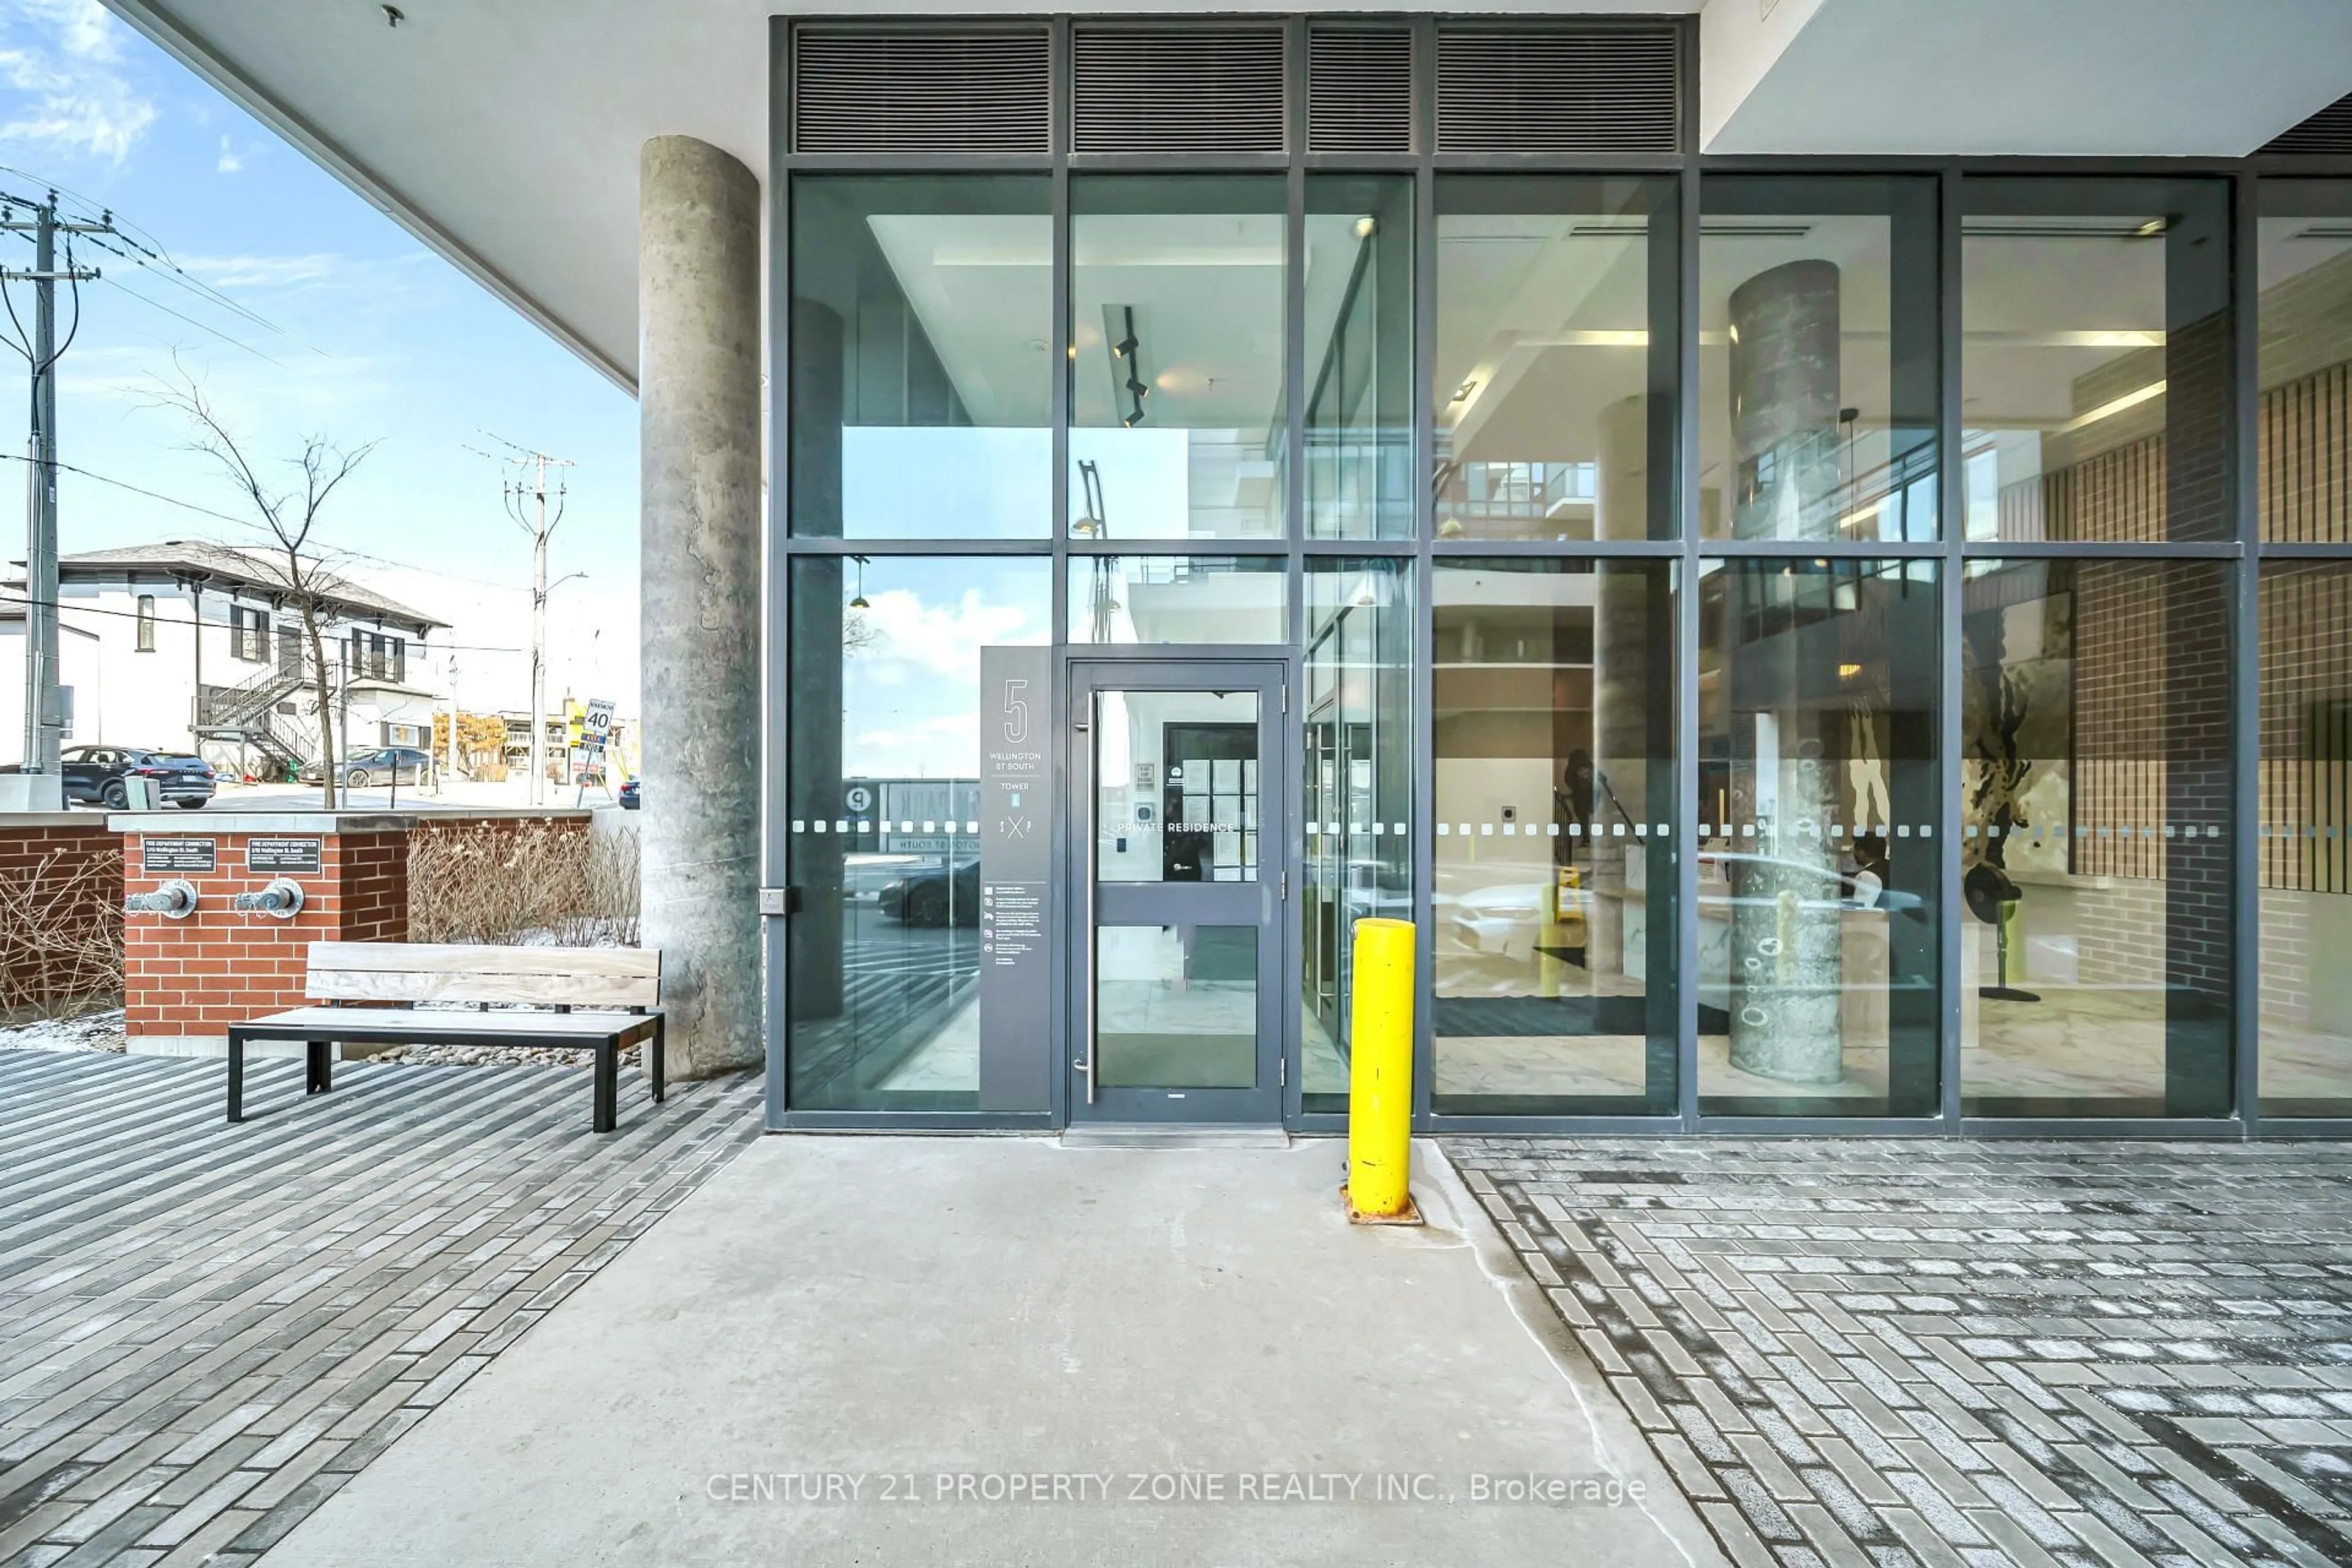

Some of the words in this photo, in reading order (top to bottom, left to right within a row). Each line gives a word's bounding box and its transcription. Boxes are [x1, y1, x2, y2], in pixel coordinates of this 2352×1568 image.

[1004, 679, 1028, 744] 5
[587, 712, 608, 728] 40
[1117, 823, 1163, 832] PRIVATE
[1168, 823, 1234, 832] RESIDENCE
